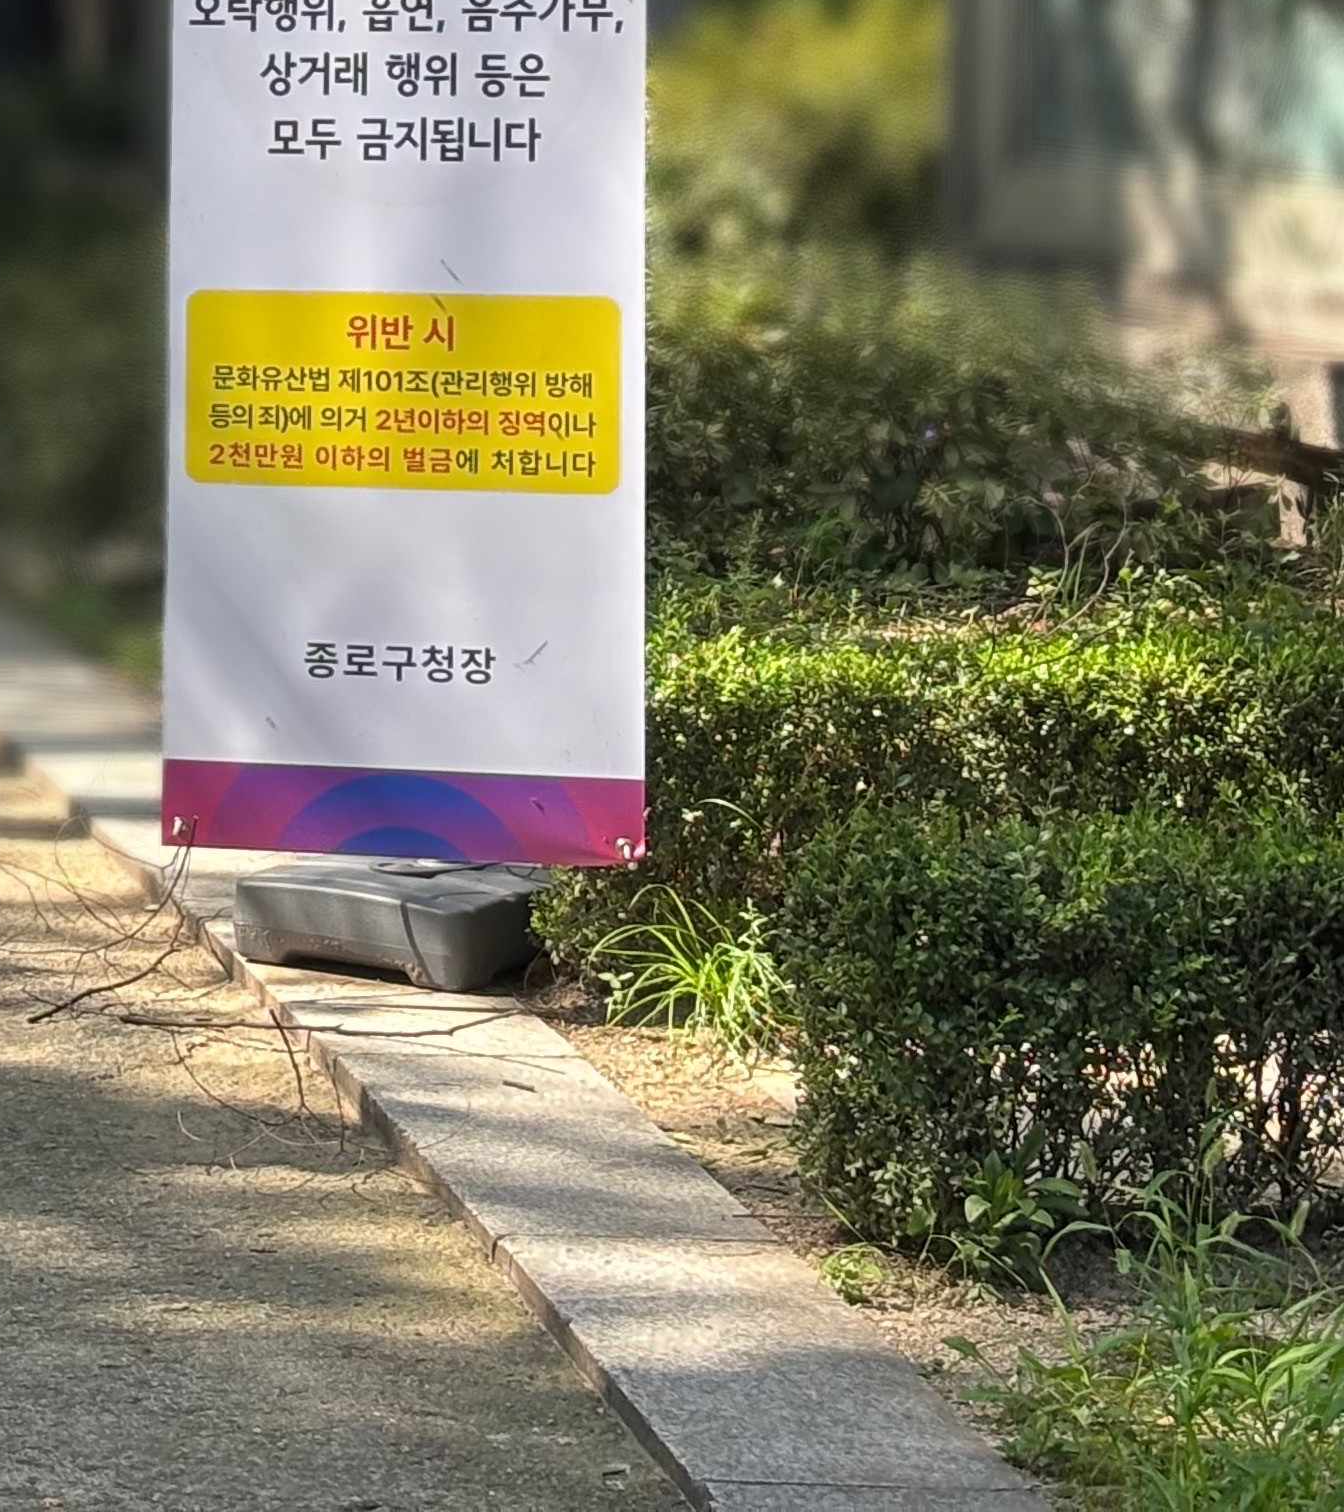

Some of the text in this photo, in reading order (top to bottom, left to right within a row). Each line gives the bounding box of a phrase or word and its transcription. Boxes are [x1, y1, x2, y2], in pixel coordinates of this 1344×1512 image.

[260, 52, 550, 97] 상거래 행위 등은
[268, 117, 541, 162] 모두 금지됩니다
[347, 315, 456, 351] 위반 시
[213, 366, 592, 399] 문화유산법 제101조(관리행위 방해
[320, 407, 366, 432] 의거
[376, 410, 489, 436] 2년이하의
[498, 411, 596, 438] 징역이나
[210, 443, 596, 477] 2천만원 이하의 벌금에 처합니다
[304, 641, 496, 685] 종로구청장
